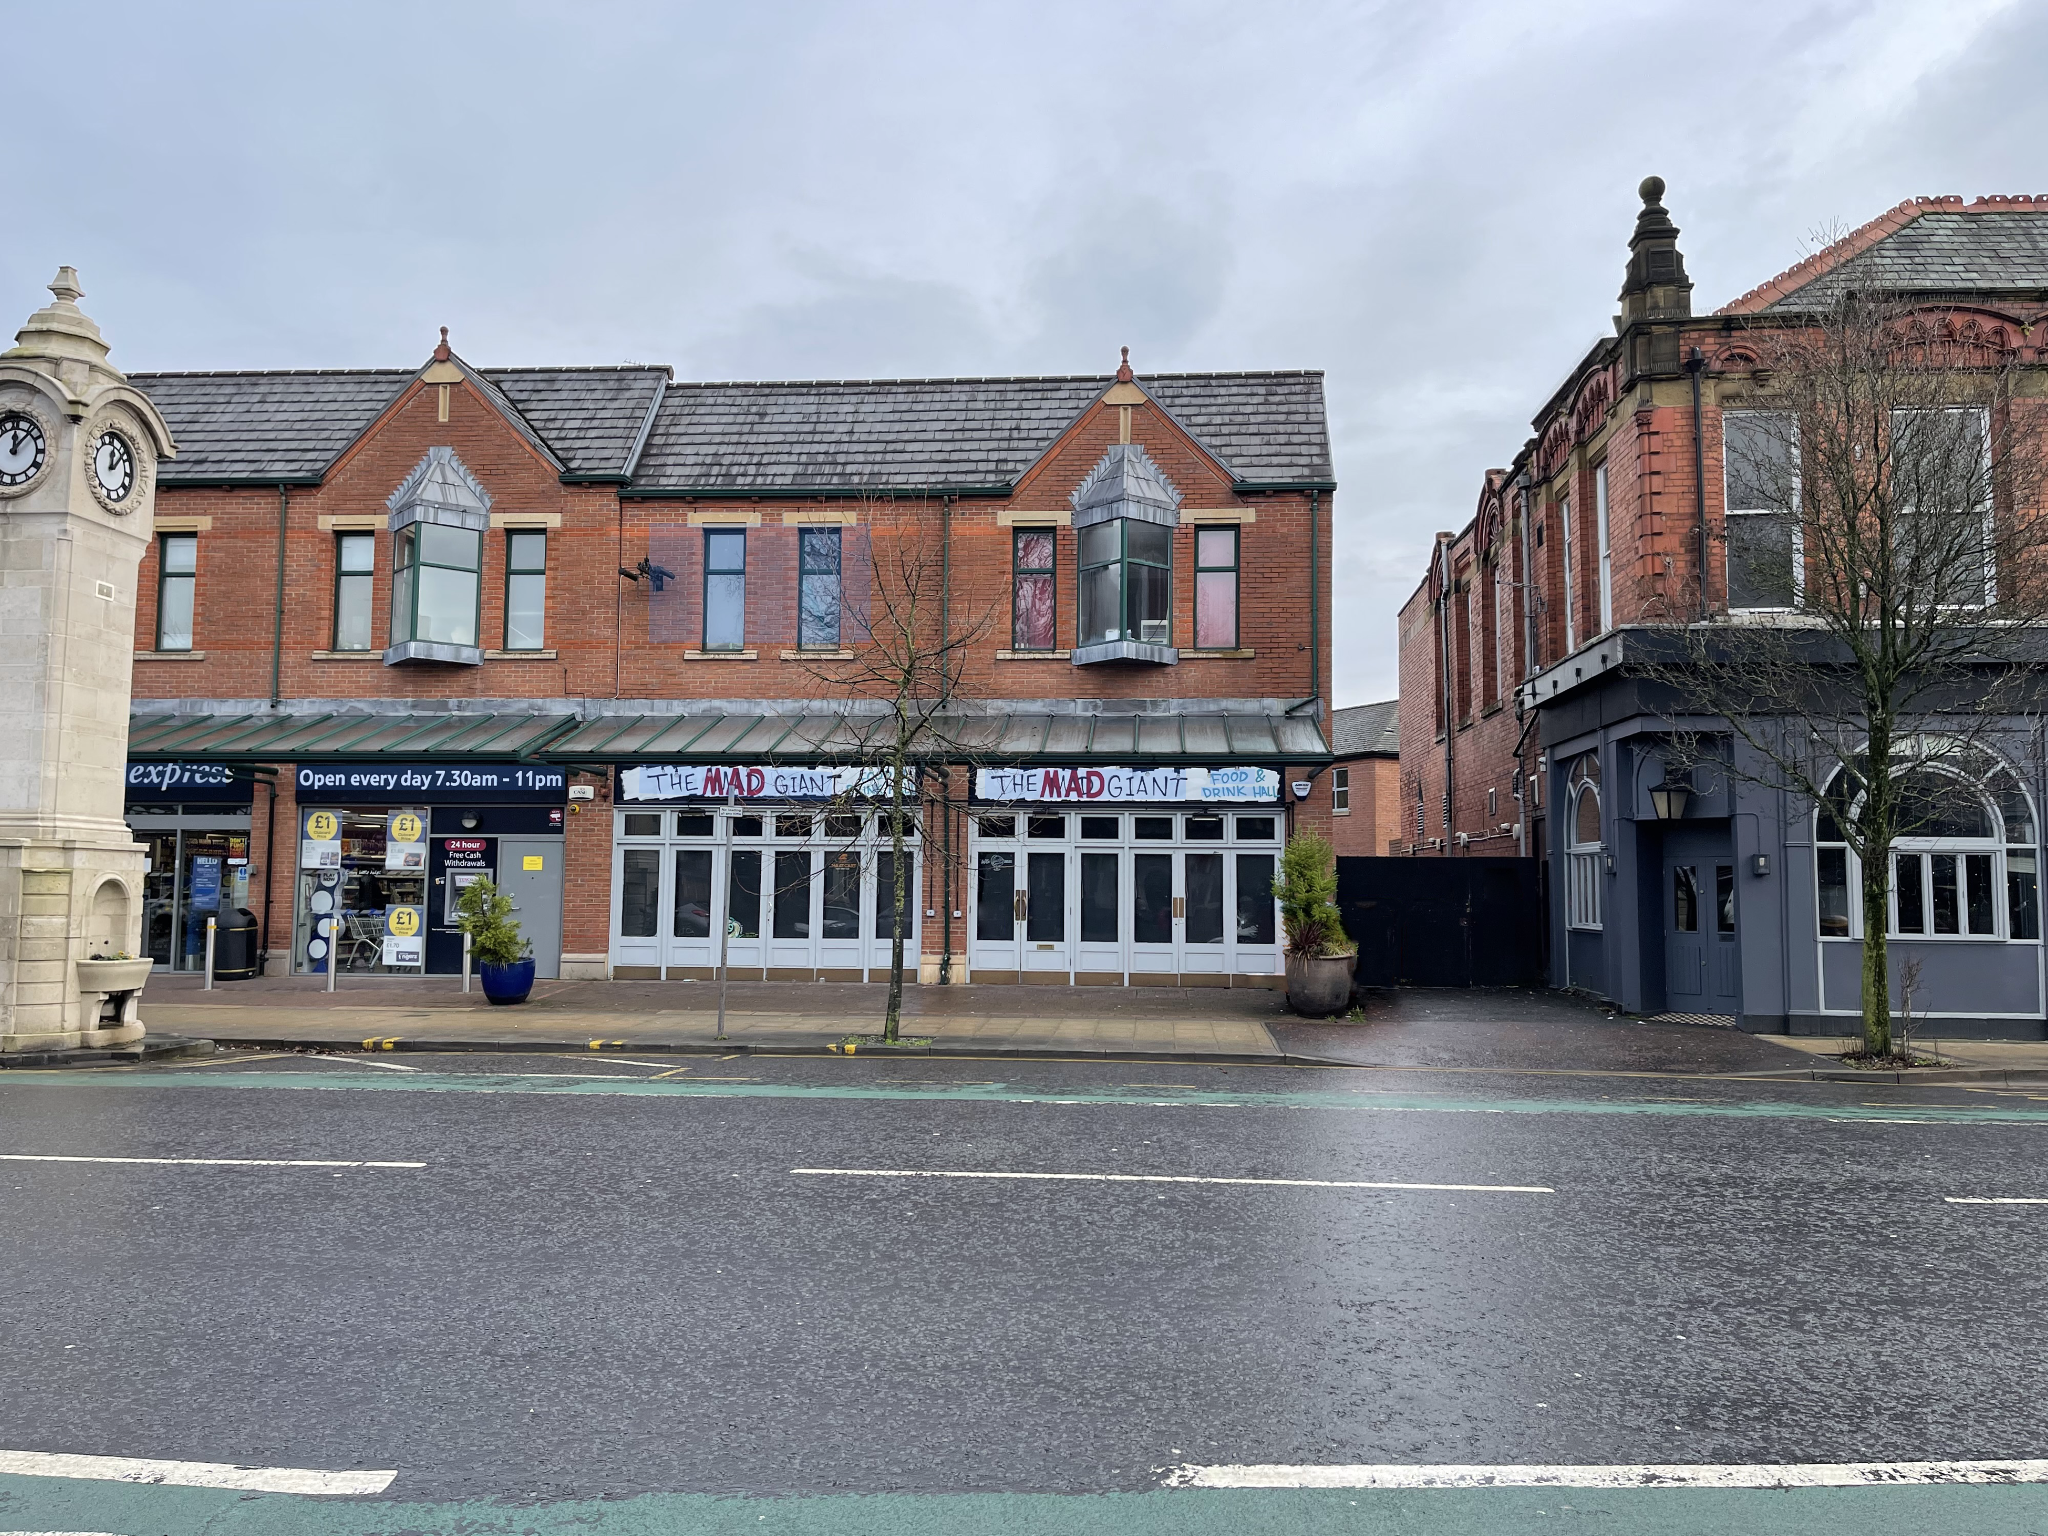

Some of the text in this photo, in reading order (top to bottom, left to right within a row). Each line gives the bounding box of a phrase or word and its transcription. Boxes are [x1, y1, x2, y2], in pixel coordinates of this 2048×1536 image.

[128, 763, 235, 791] express
[299, 769, 346, 790] Open
[350, 773, 398, 790] every
[400, 769, 432, 790] day
[435, 770, 498, 787] 7.30am
[515, 770, 562, 790] 11pm
[647, 767, 843, 797] THE MAD GIANT
[1210, 768, 1266, 785] FOOD &
[990, 769, 1189, 799] THE MAD GIANT
[1202, 785, 1281, 798] DRINK HALL
[314, 815, 331, 829] £1
[398, 817, 415, 831] £1
[450, 840, 481, 849] 24 hour
[196, 857, 218, 865] HELLO
[449, 851, 482, 859] Free Cash
[444, 859, 486, 867] Withdrawals
[396, 911, 412, 925] £1
